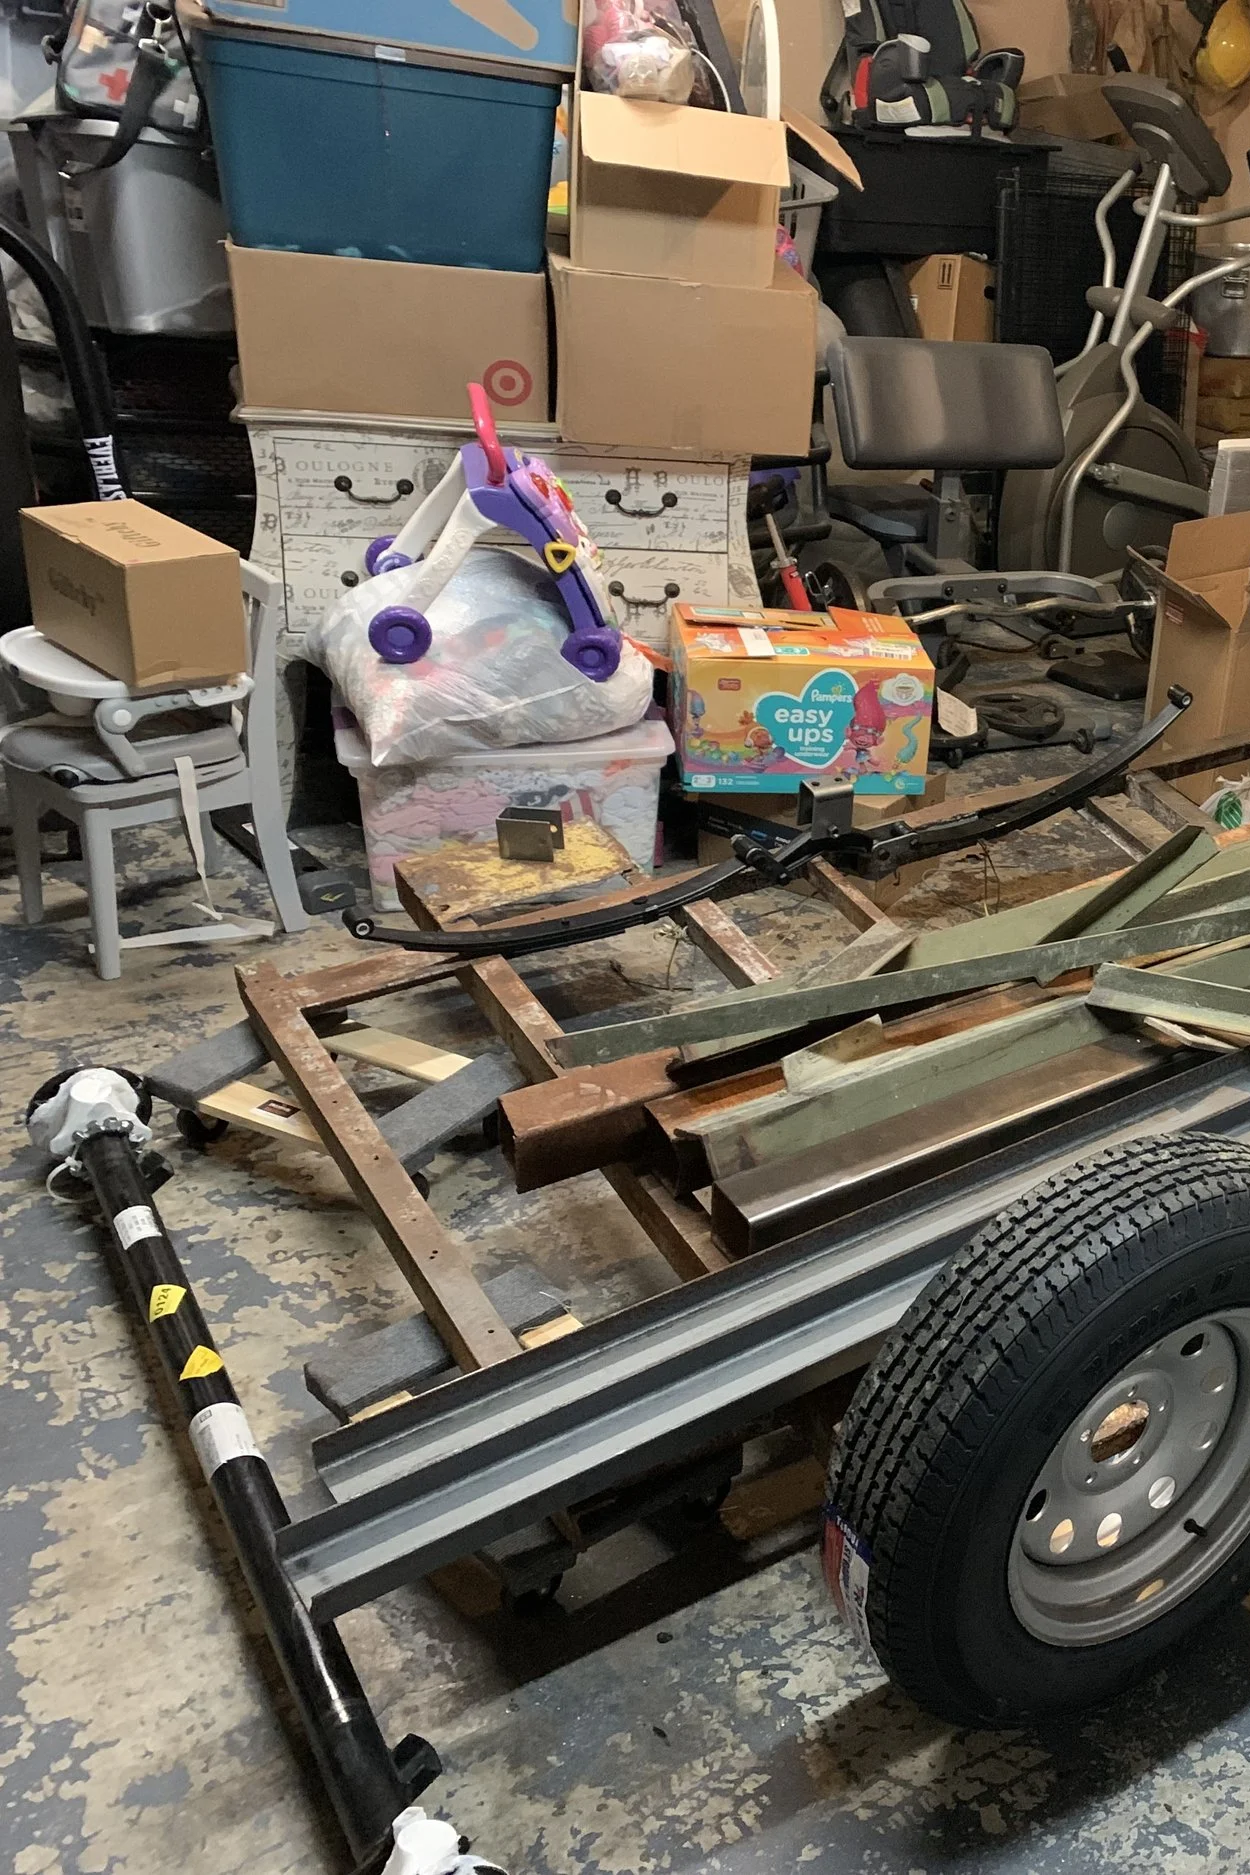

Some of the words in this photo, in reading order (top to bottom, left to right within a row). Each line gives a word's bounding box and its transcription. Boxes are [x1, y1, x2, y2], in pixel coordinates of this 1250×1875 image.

[83, 434, 126, 500] EVERLAS
[810, 688, 853, 705] Pampers
[774, 708, 833, 728] easy
[788, 727, 834, 746] ups
[718, 777, 734, 786] 132
